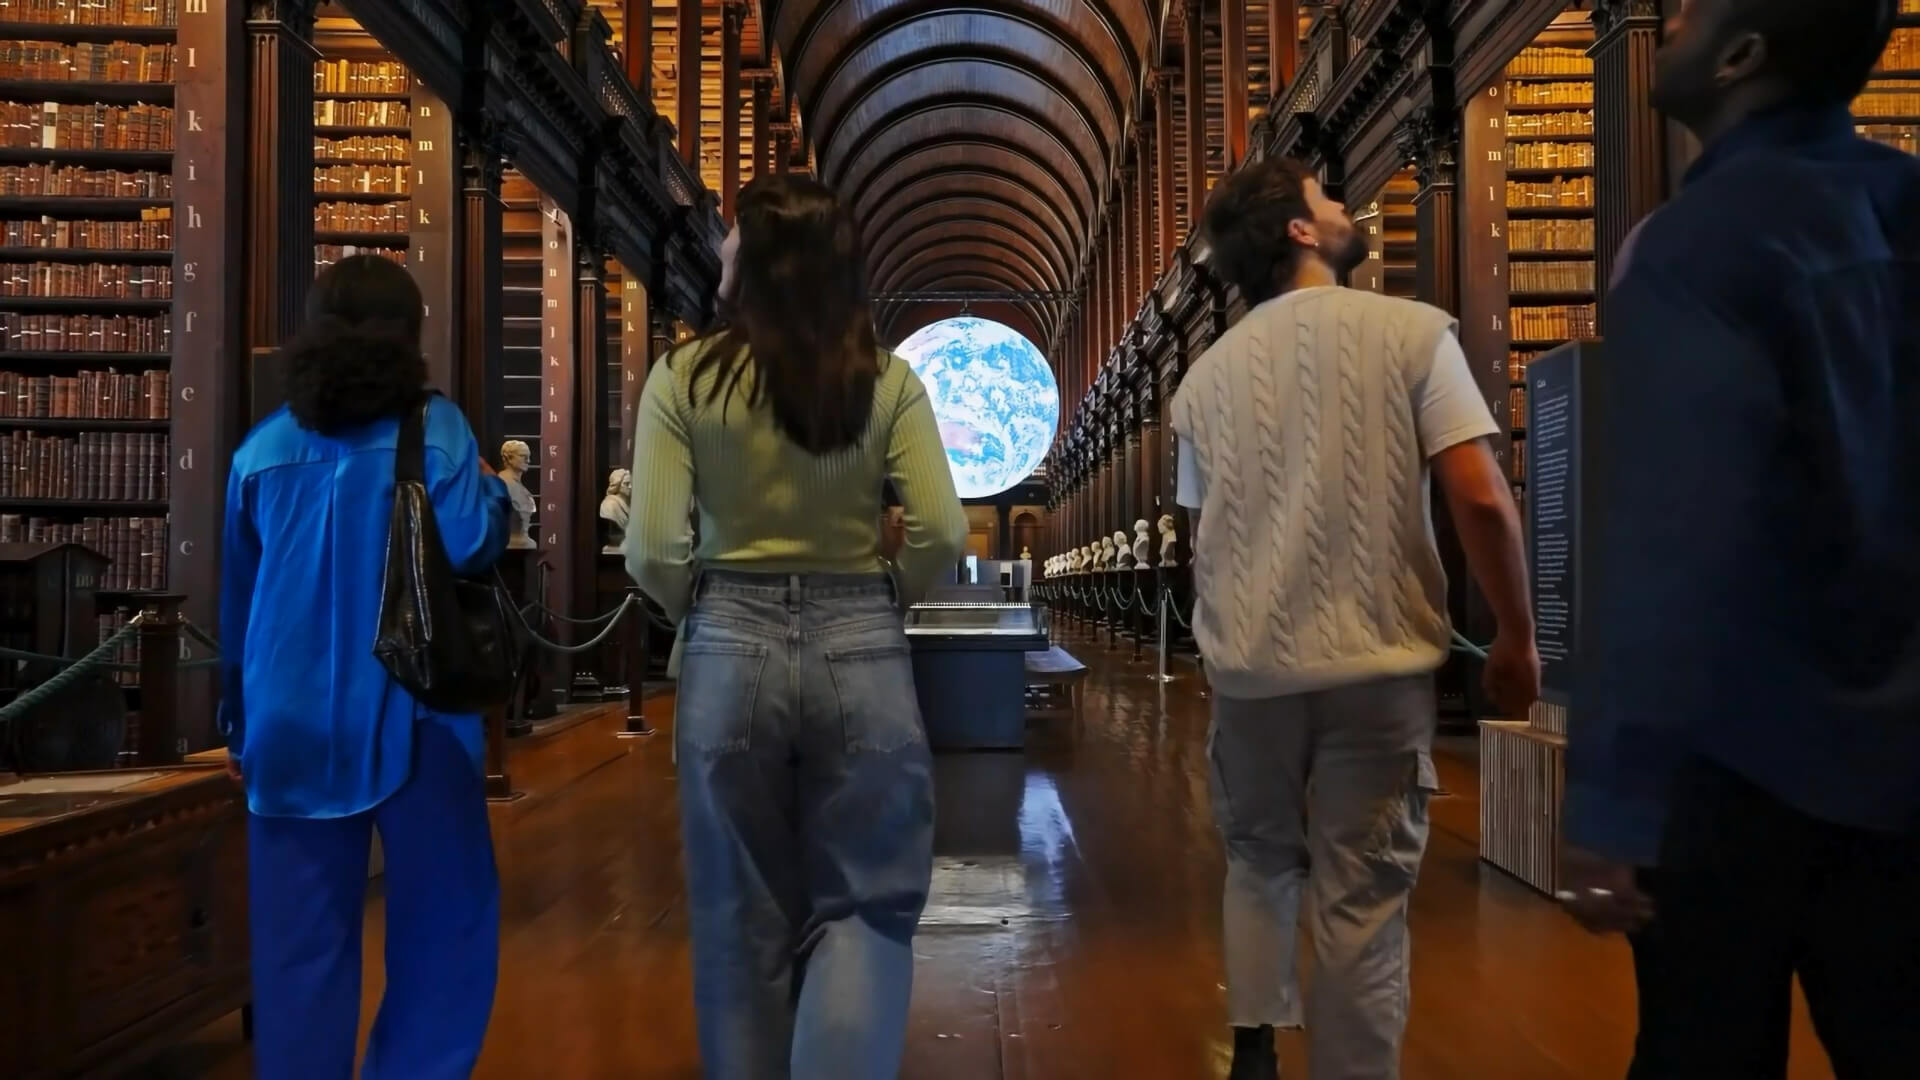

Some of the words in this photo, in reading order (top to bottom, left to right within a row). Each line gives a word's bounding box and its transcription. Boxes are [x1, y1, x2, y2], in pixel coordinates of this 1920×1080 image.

[185, 0, 208, 14] m
[188, 47, 196, 68] l
[1488, 86, 1498, 97] o
[420, 106, 431, 117] n
[187, 109, 203, 132] k
[1489, 117, 1499, 128] n
[418, 140, 433, 151] m
[1487, 150, 1502, 161] m
[188, 159, 196, 181] i
[188, 206, 202, 229] h
[419, 208, 431, 224] k
[1491, 222, 1501, 238] k
[548, 240, 559, 250] o
[418, 246, 425, 262] i
[1368, 250, 1380, 260] m
[183, 262, 198, 281] g
[626, 281, 638, 290] m
[547, 298, 558, 308] m
[185, 311, 197, 333] f
[1492, 314, 1503, 331] h
[550, 355, 560, 367] k
[1492, 359, 1502, 373] g
[627, 370, 635, 382] h
[181, 386, 195, 402] e
[549, 410, 558, 423] h
[179, 448, 193, 470] d
[548, 533, 557, 545] d
[179, 540, 193, 555] c
[179, 636, 192, 660] b
